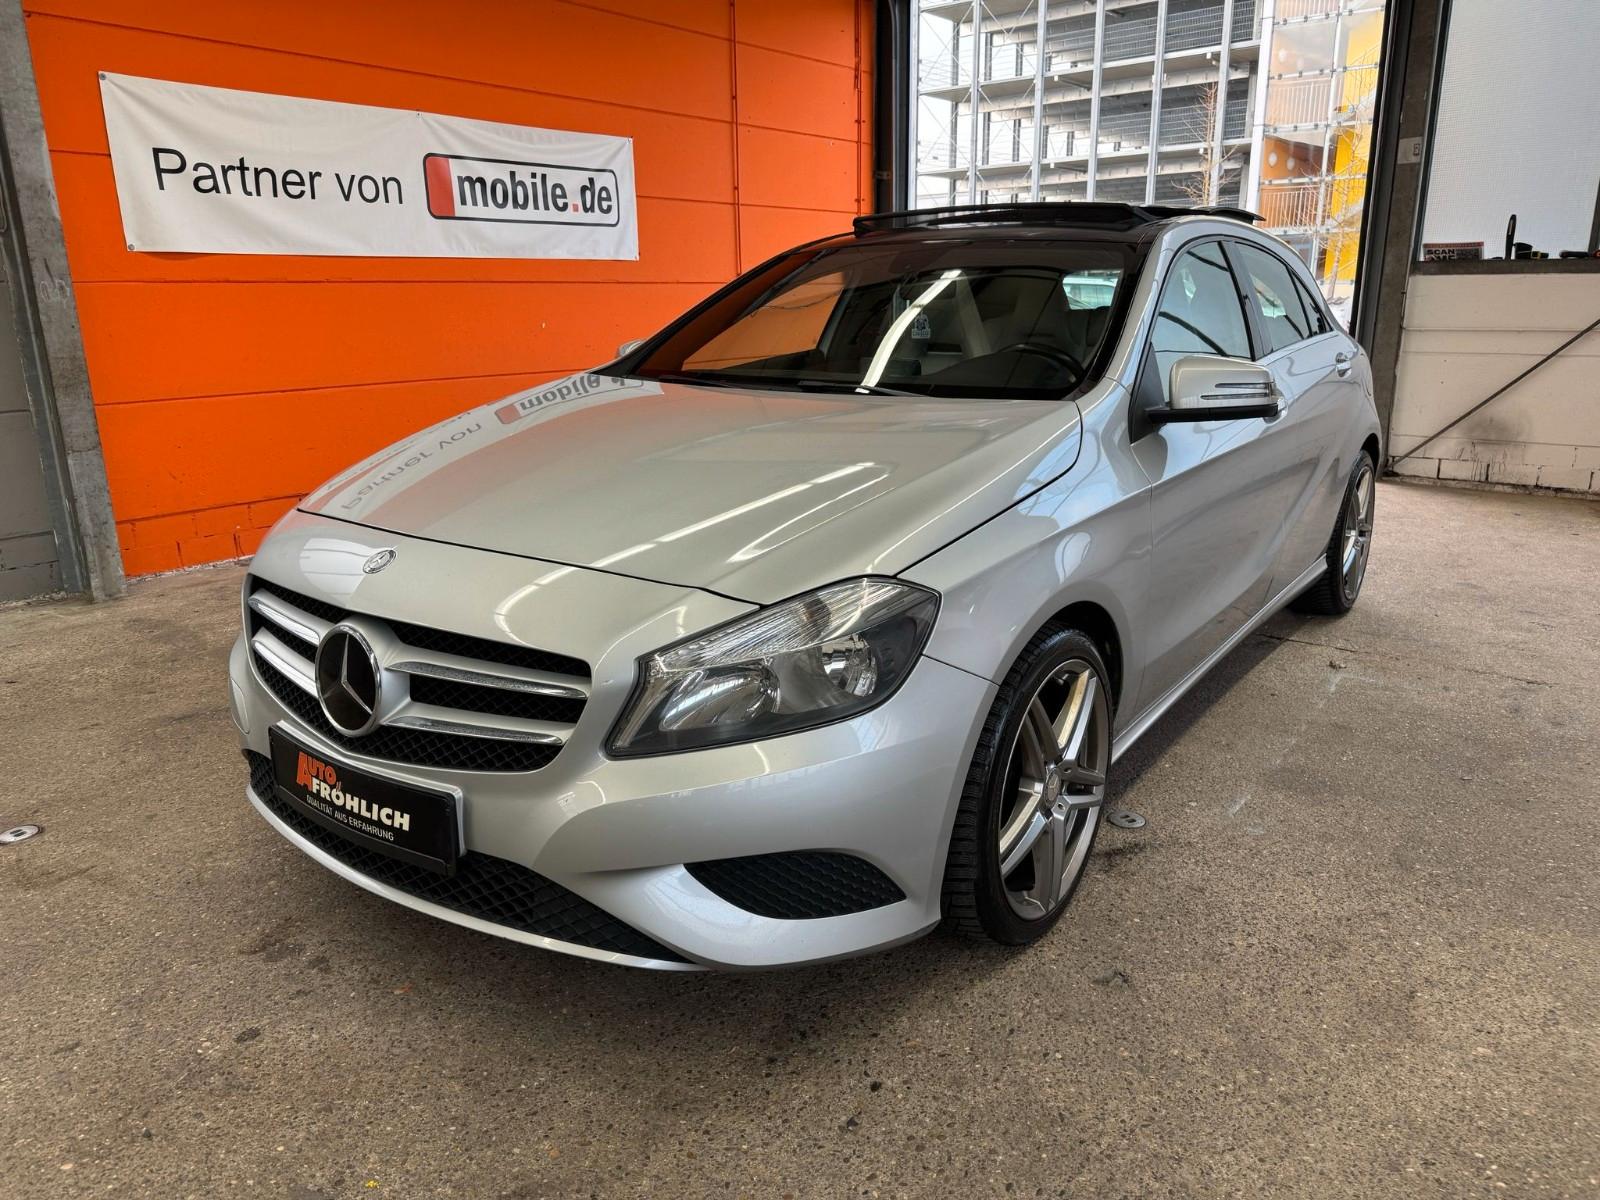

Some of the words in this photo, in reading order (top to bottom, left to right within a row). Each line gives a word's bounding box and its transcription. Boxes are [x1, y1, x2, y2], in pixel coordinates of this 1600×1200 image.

[151, 147, 322, 200] Partner
[334, 171, 404, 205] von
[457, 170, 614, 215] mobile.de
[296, 751, 337, 792] AUTO
[306, 794, 334, 815] QUALITÄT
[334, 810, 348, 823] AUS
[348, 816, 394, 841] ERFAHRUNG
[311, 776, 411, 832] FRÖHLICH
